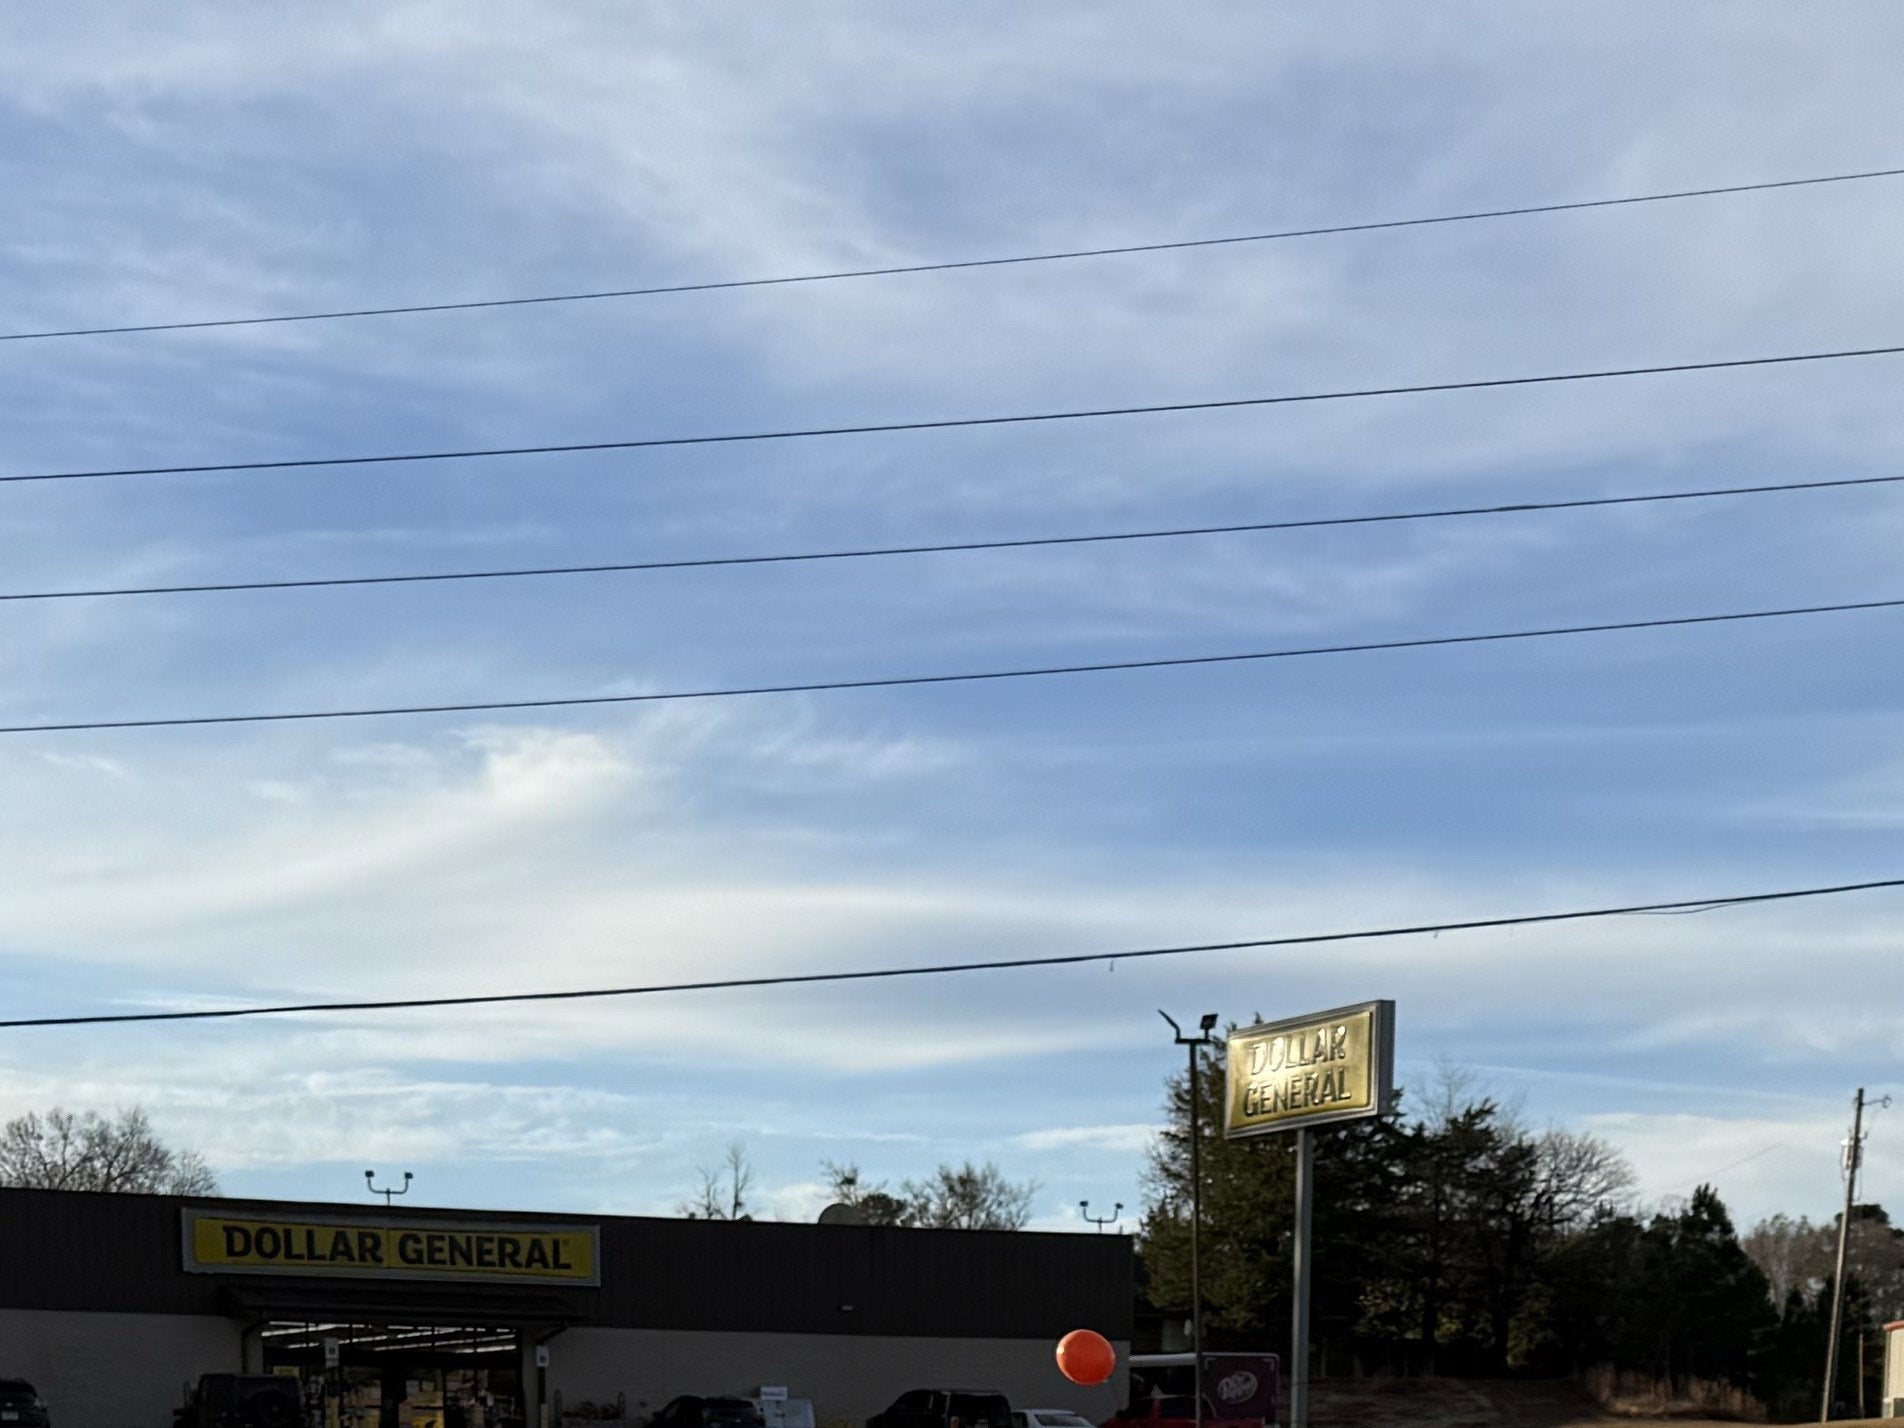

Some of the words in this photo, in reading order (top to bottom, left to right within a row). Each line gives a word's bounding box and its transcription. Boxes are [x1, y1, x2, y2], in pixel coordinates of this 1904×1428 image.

[1249, 1025, 1347, 1076] DOLLAR
[1243, 1066, 1352, 1118] GENERAL
[222, 1225, 384, 1264] DOLLAR
[398, 1233, 572, 1271] GENERAL
